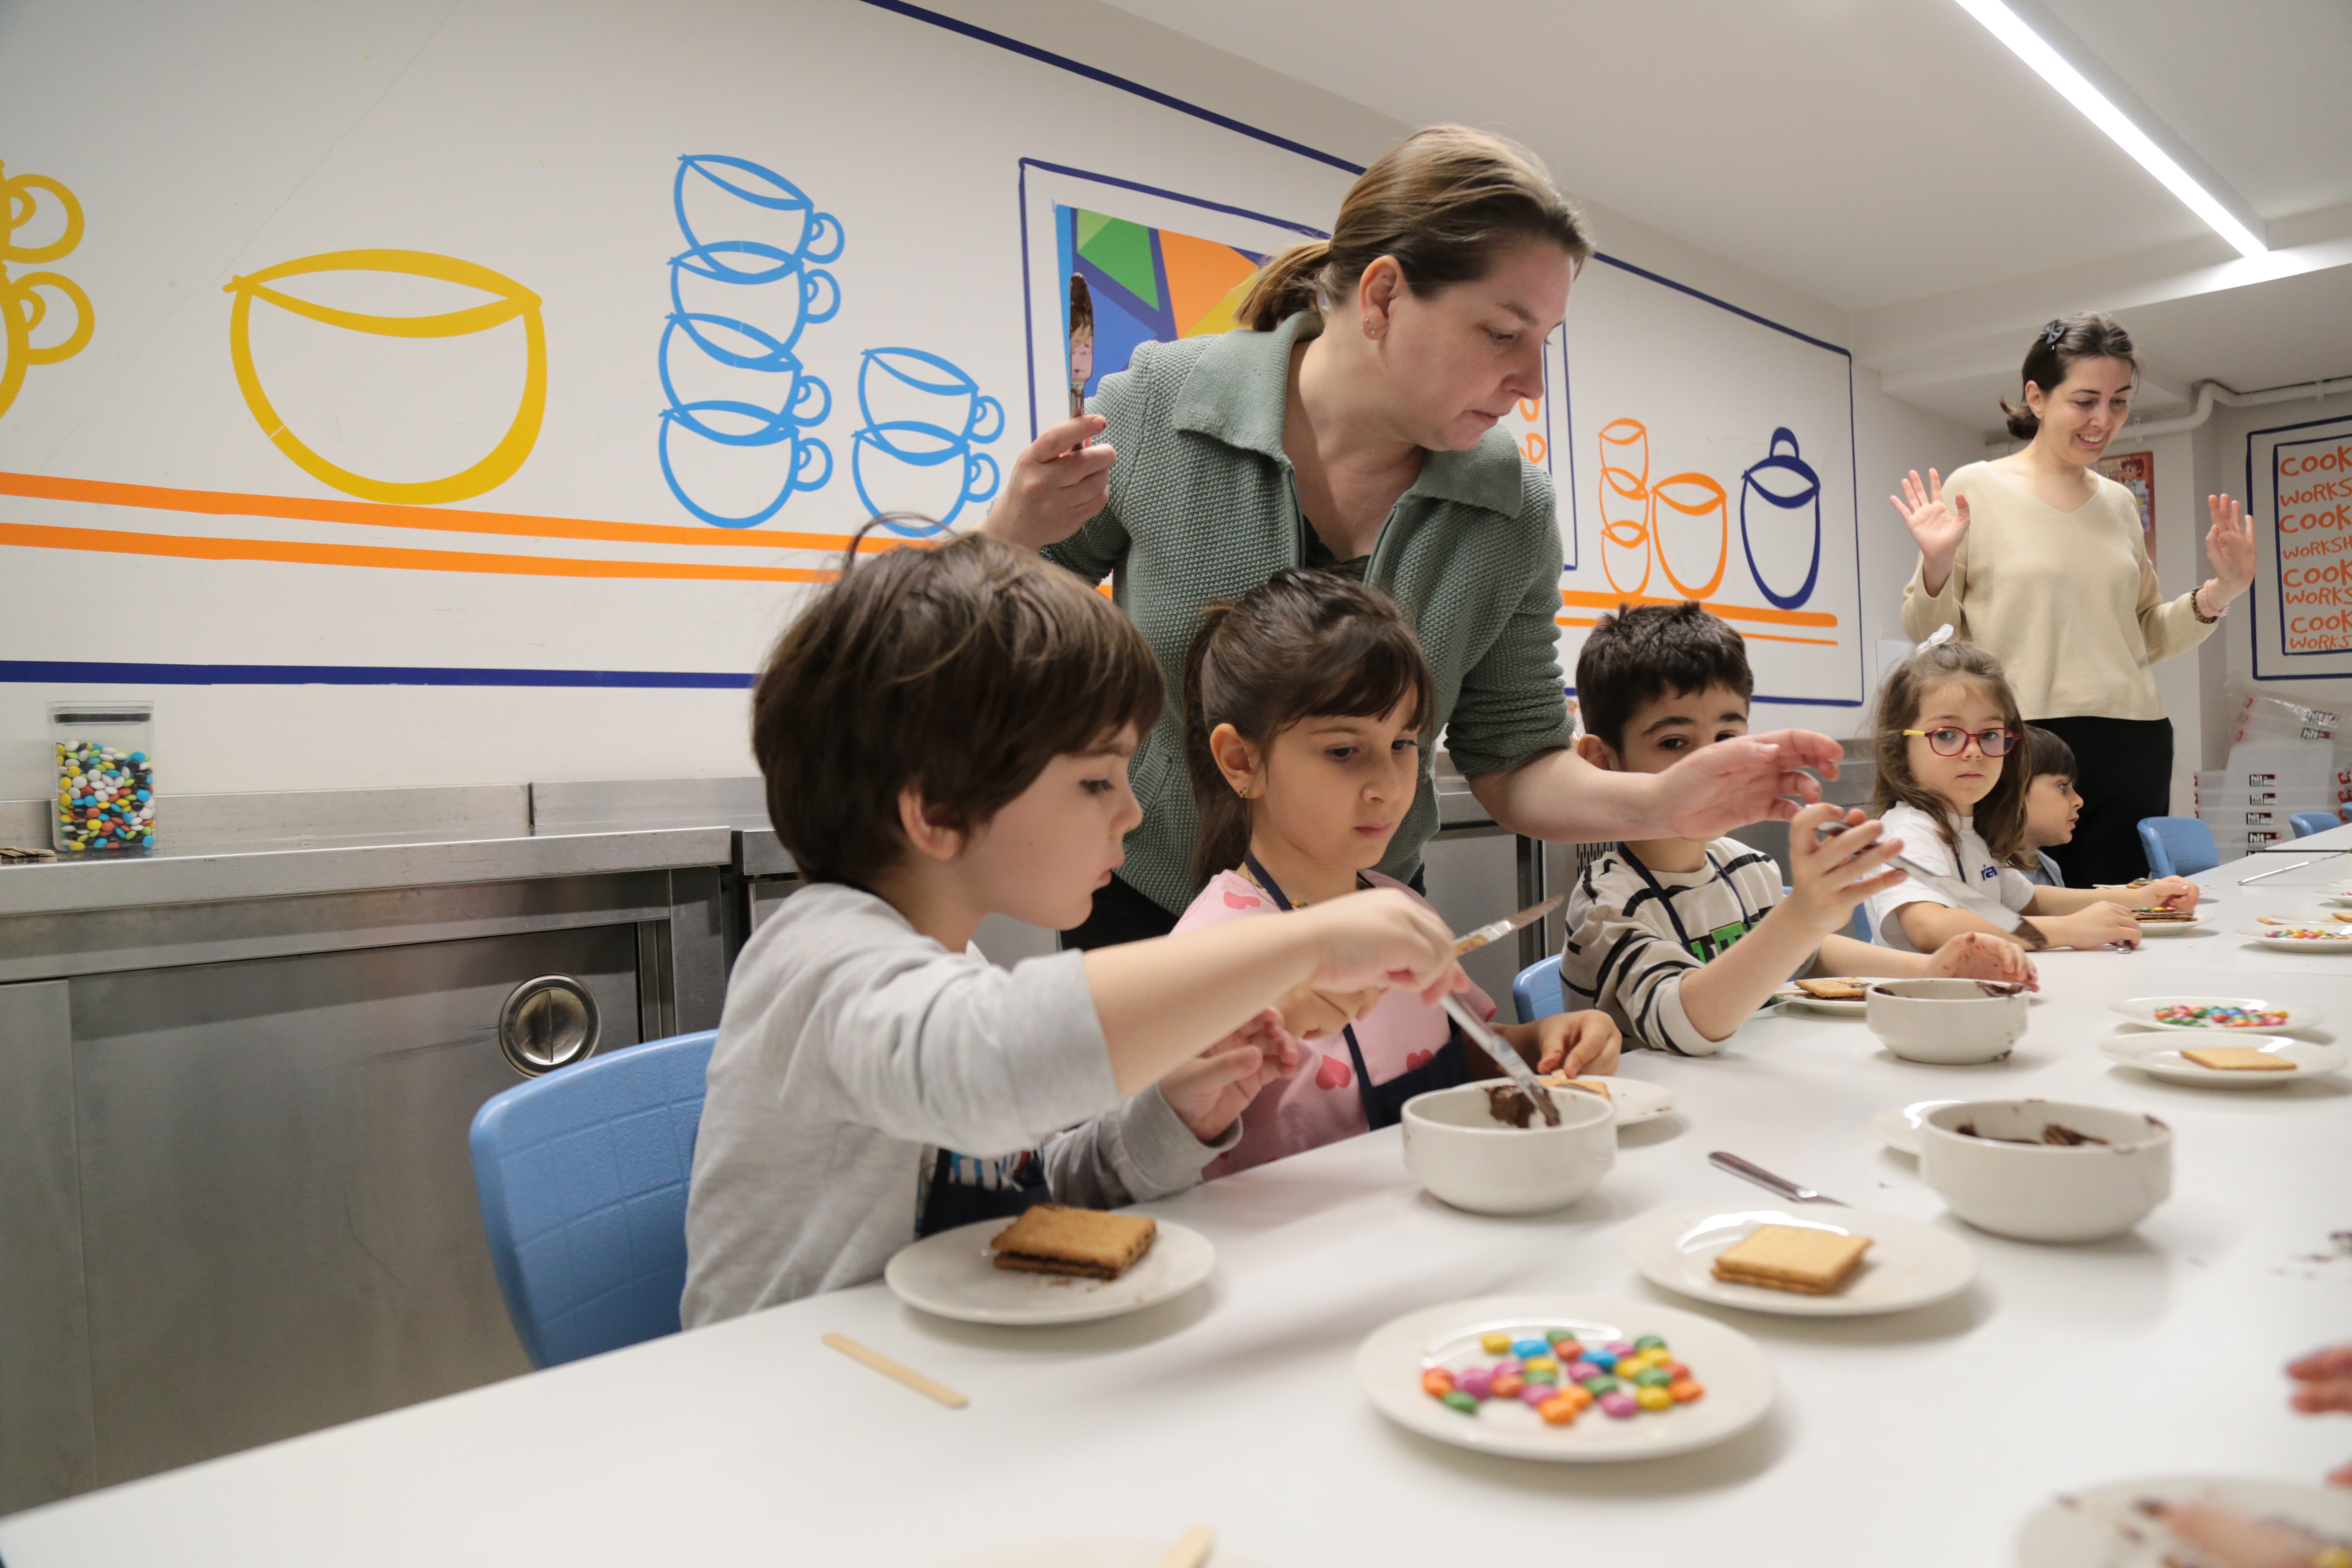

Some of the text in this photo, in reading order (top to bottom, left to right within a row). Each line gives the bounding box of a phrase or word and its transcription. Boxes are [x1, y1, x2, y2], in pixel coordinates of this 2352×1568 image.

[2280, 446, 2352, 476] COOK
[2280, 478, 2352, 507] WORKS
[2279, 504, 2352, 533] COOK
[2283, 559, 2352, 588] COOK
[2291, 609, 2352, 634] COOK
[2290, 634, 2352, 650] WORKS
[2249, 833, 2265, 842] hit
